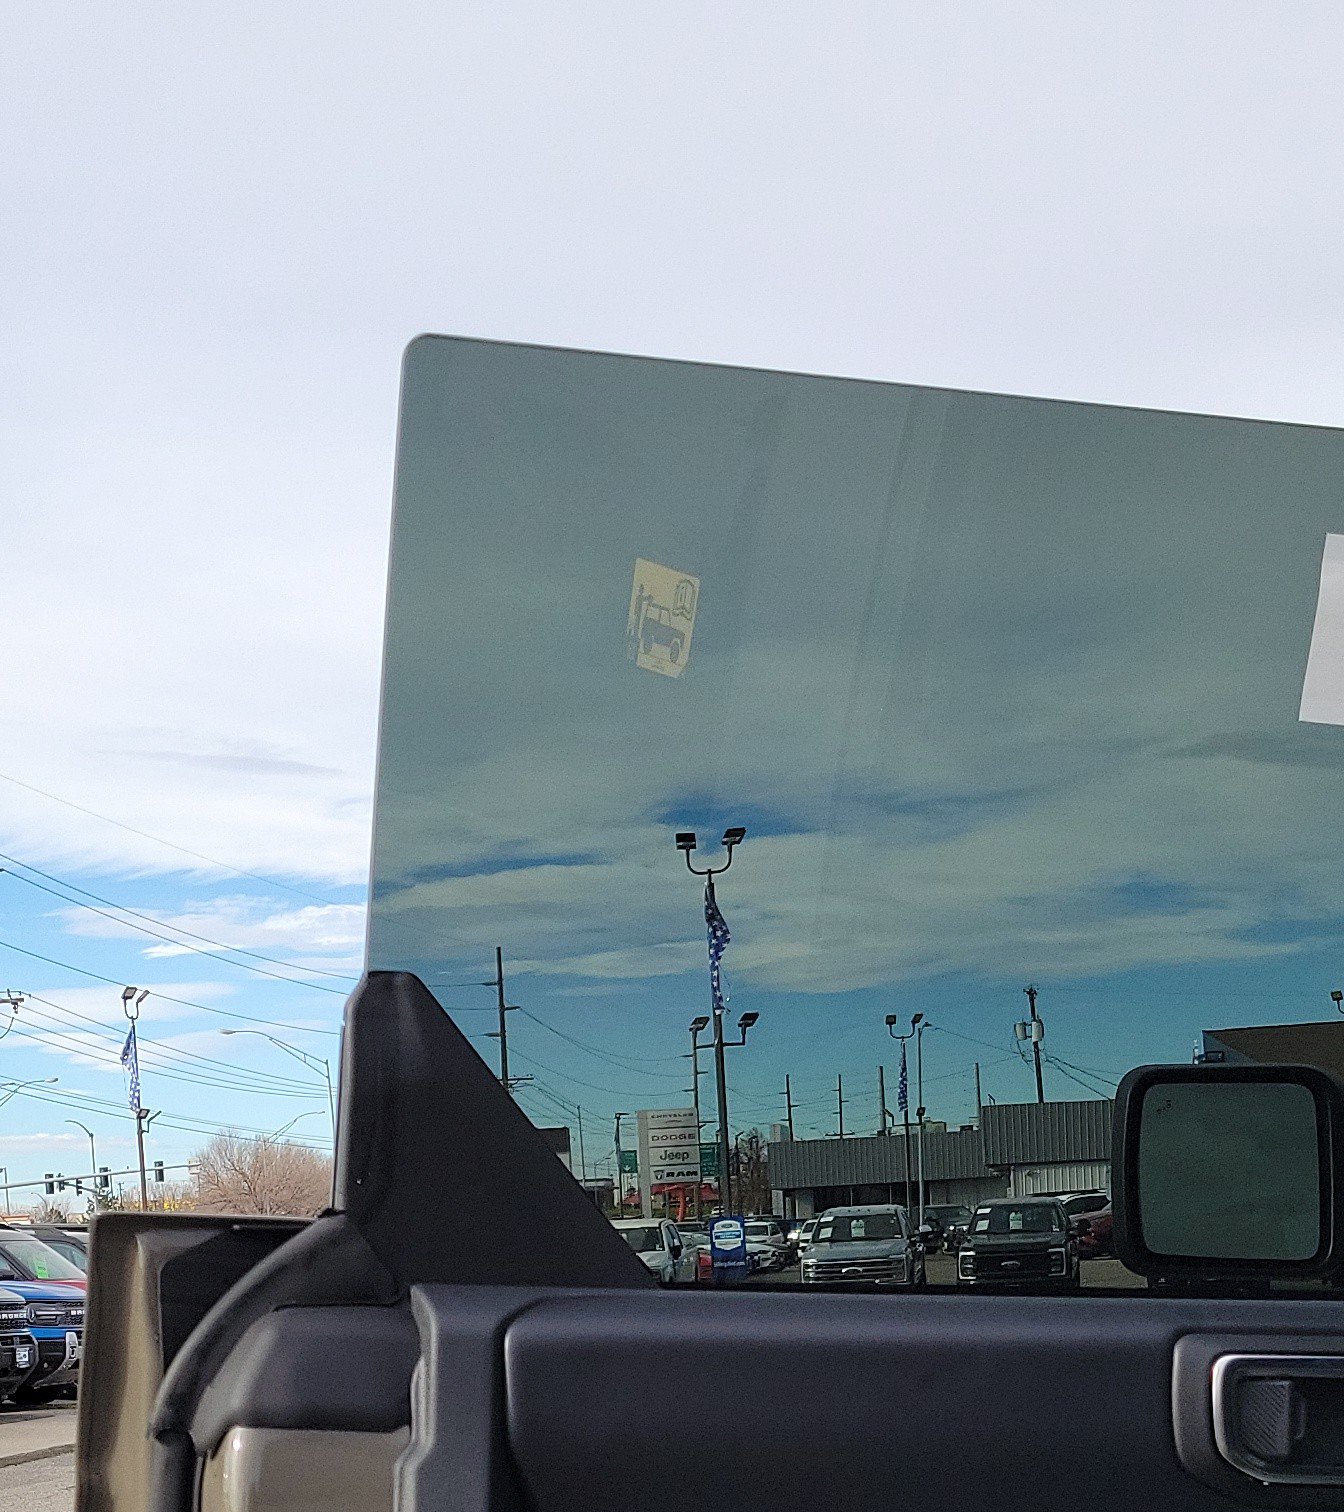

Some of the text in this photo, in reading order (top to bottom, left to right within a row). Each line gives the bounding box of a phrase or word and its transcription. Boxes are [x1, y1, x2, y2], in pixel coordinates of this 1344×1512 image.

[651, 1133, 696, 1142] DODGE
[660, 1150, 689, 1161] Jeep
[665, 1170, 698, 1178] RAM
